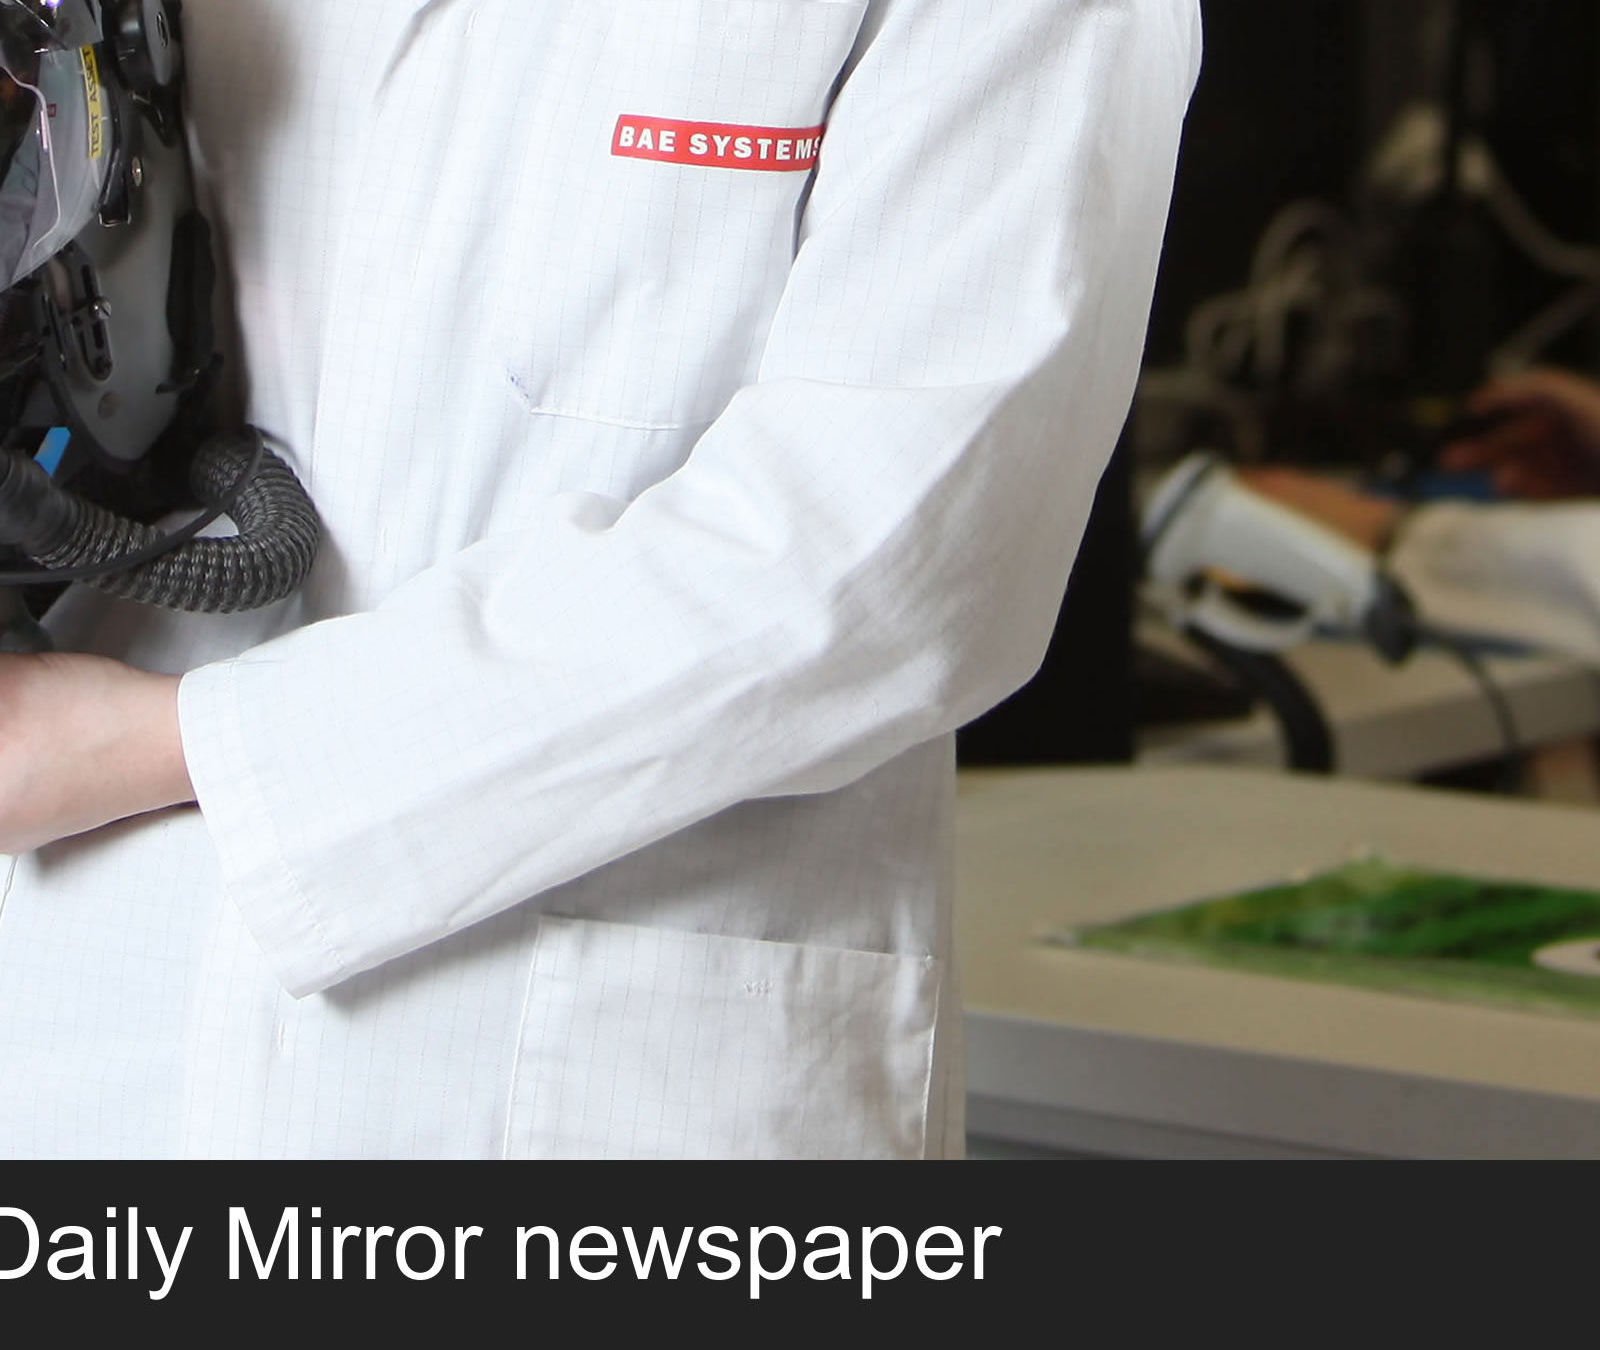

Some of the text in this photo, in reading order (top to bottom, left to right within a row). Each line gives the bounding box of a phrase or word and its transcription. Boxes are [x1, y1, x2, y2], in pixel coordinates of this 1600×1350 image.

[83, 51, 100, 156] TEST ASSET
[619, 125, 676, 153] BAE
